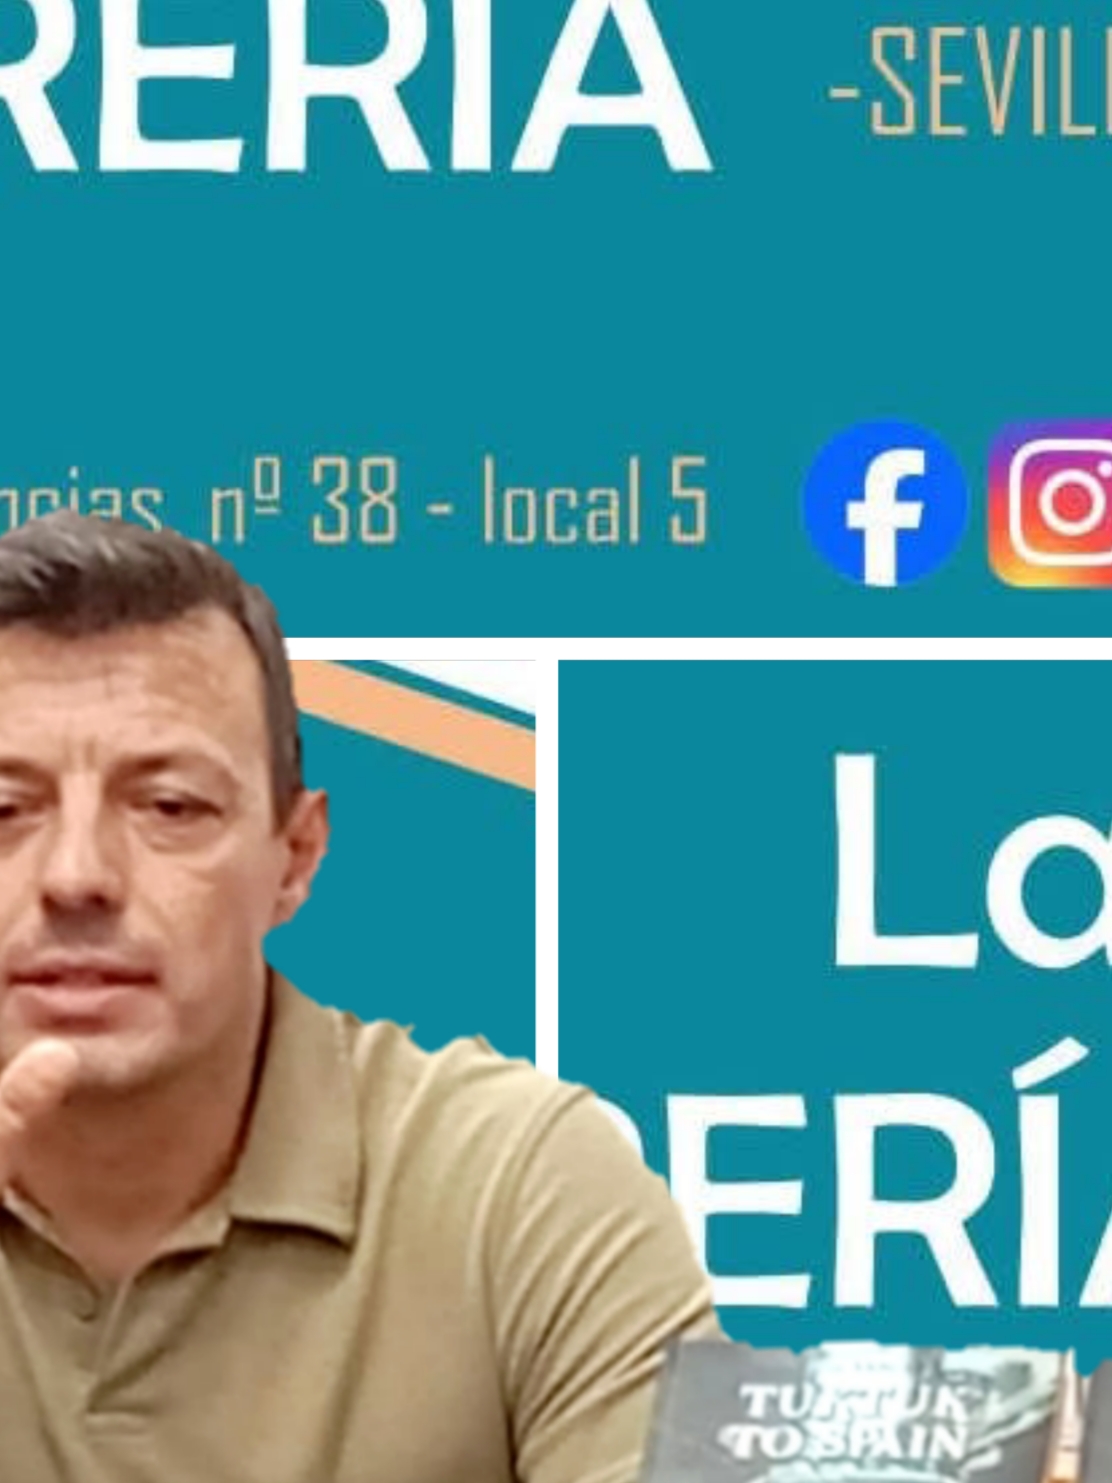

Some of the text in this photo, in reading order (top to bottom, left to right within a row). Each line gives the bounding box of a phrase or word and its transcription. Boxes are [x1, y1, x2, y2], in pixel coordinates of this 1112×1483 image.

[211, 455, 280, 545] nº
[312, 455, 398, 545] 38
[485, 455, 640, 545] local
[670, 455, 709, 545] 5
[717, 1421, 968, 1460] TO SPAIN
